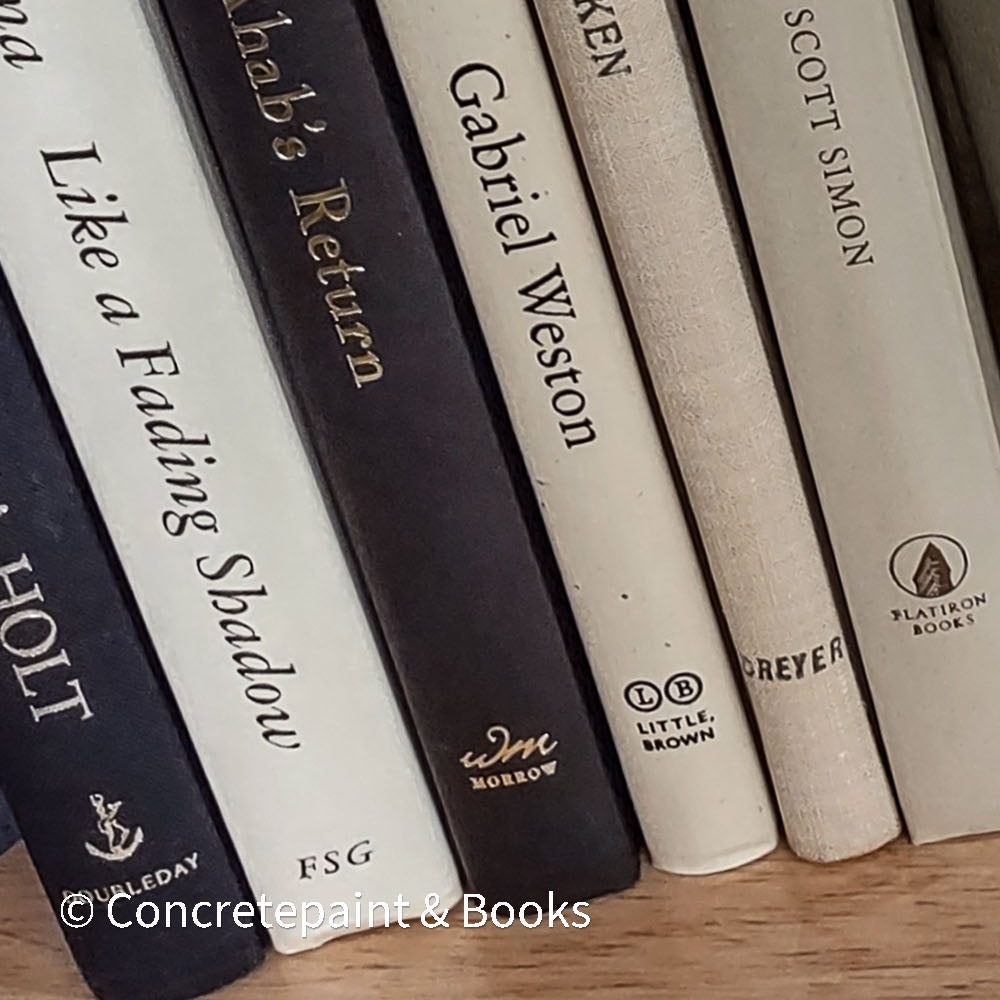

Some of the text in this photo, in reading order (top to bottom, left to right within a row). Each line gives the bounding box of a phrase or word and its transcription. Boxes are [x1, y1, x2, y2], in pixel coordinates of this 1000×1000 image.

[783, 8, 875, 269] SCOTT SIMON
[39, 141, 129, 271] Like
[449, 61, 598, 450] Gabriel Weston
[95, 292, 141, 327] a
[288, 176, 385, 390] Return
[115, 340, 219, 537] Fading
[0, 552, 94, 723] HOLT
[197, 553, 301, 751] Shadow
[890, 591, 987, 622] FLATIRON
[912, 613, 975, 636] BOOKS
[469, 759, 558, 790] MORROW
[642, 726, 716, 752] BROWN
[296, 839, 375, 881] FSG
